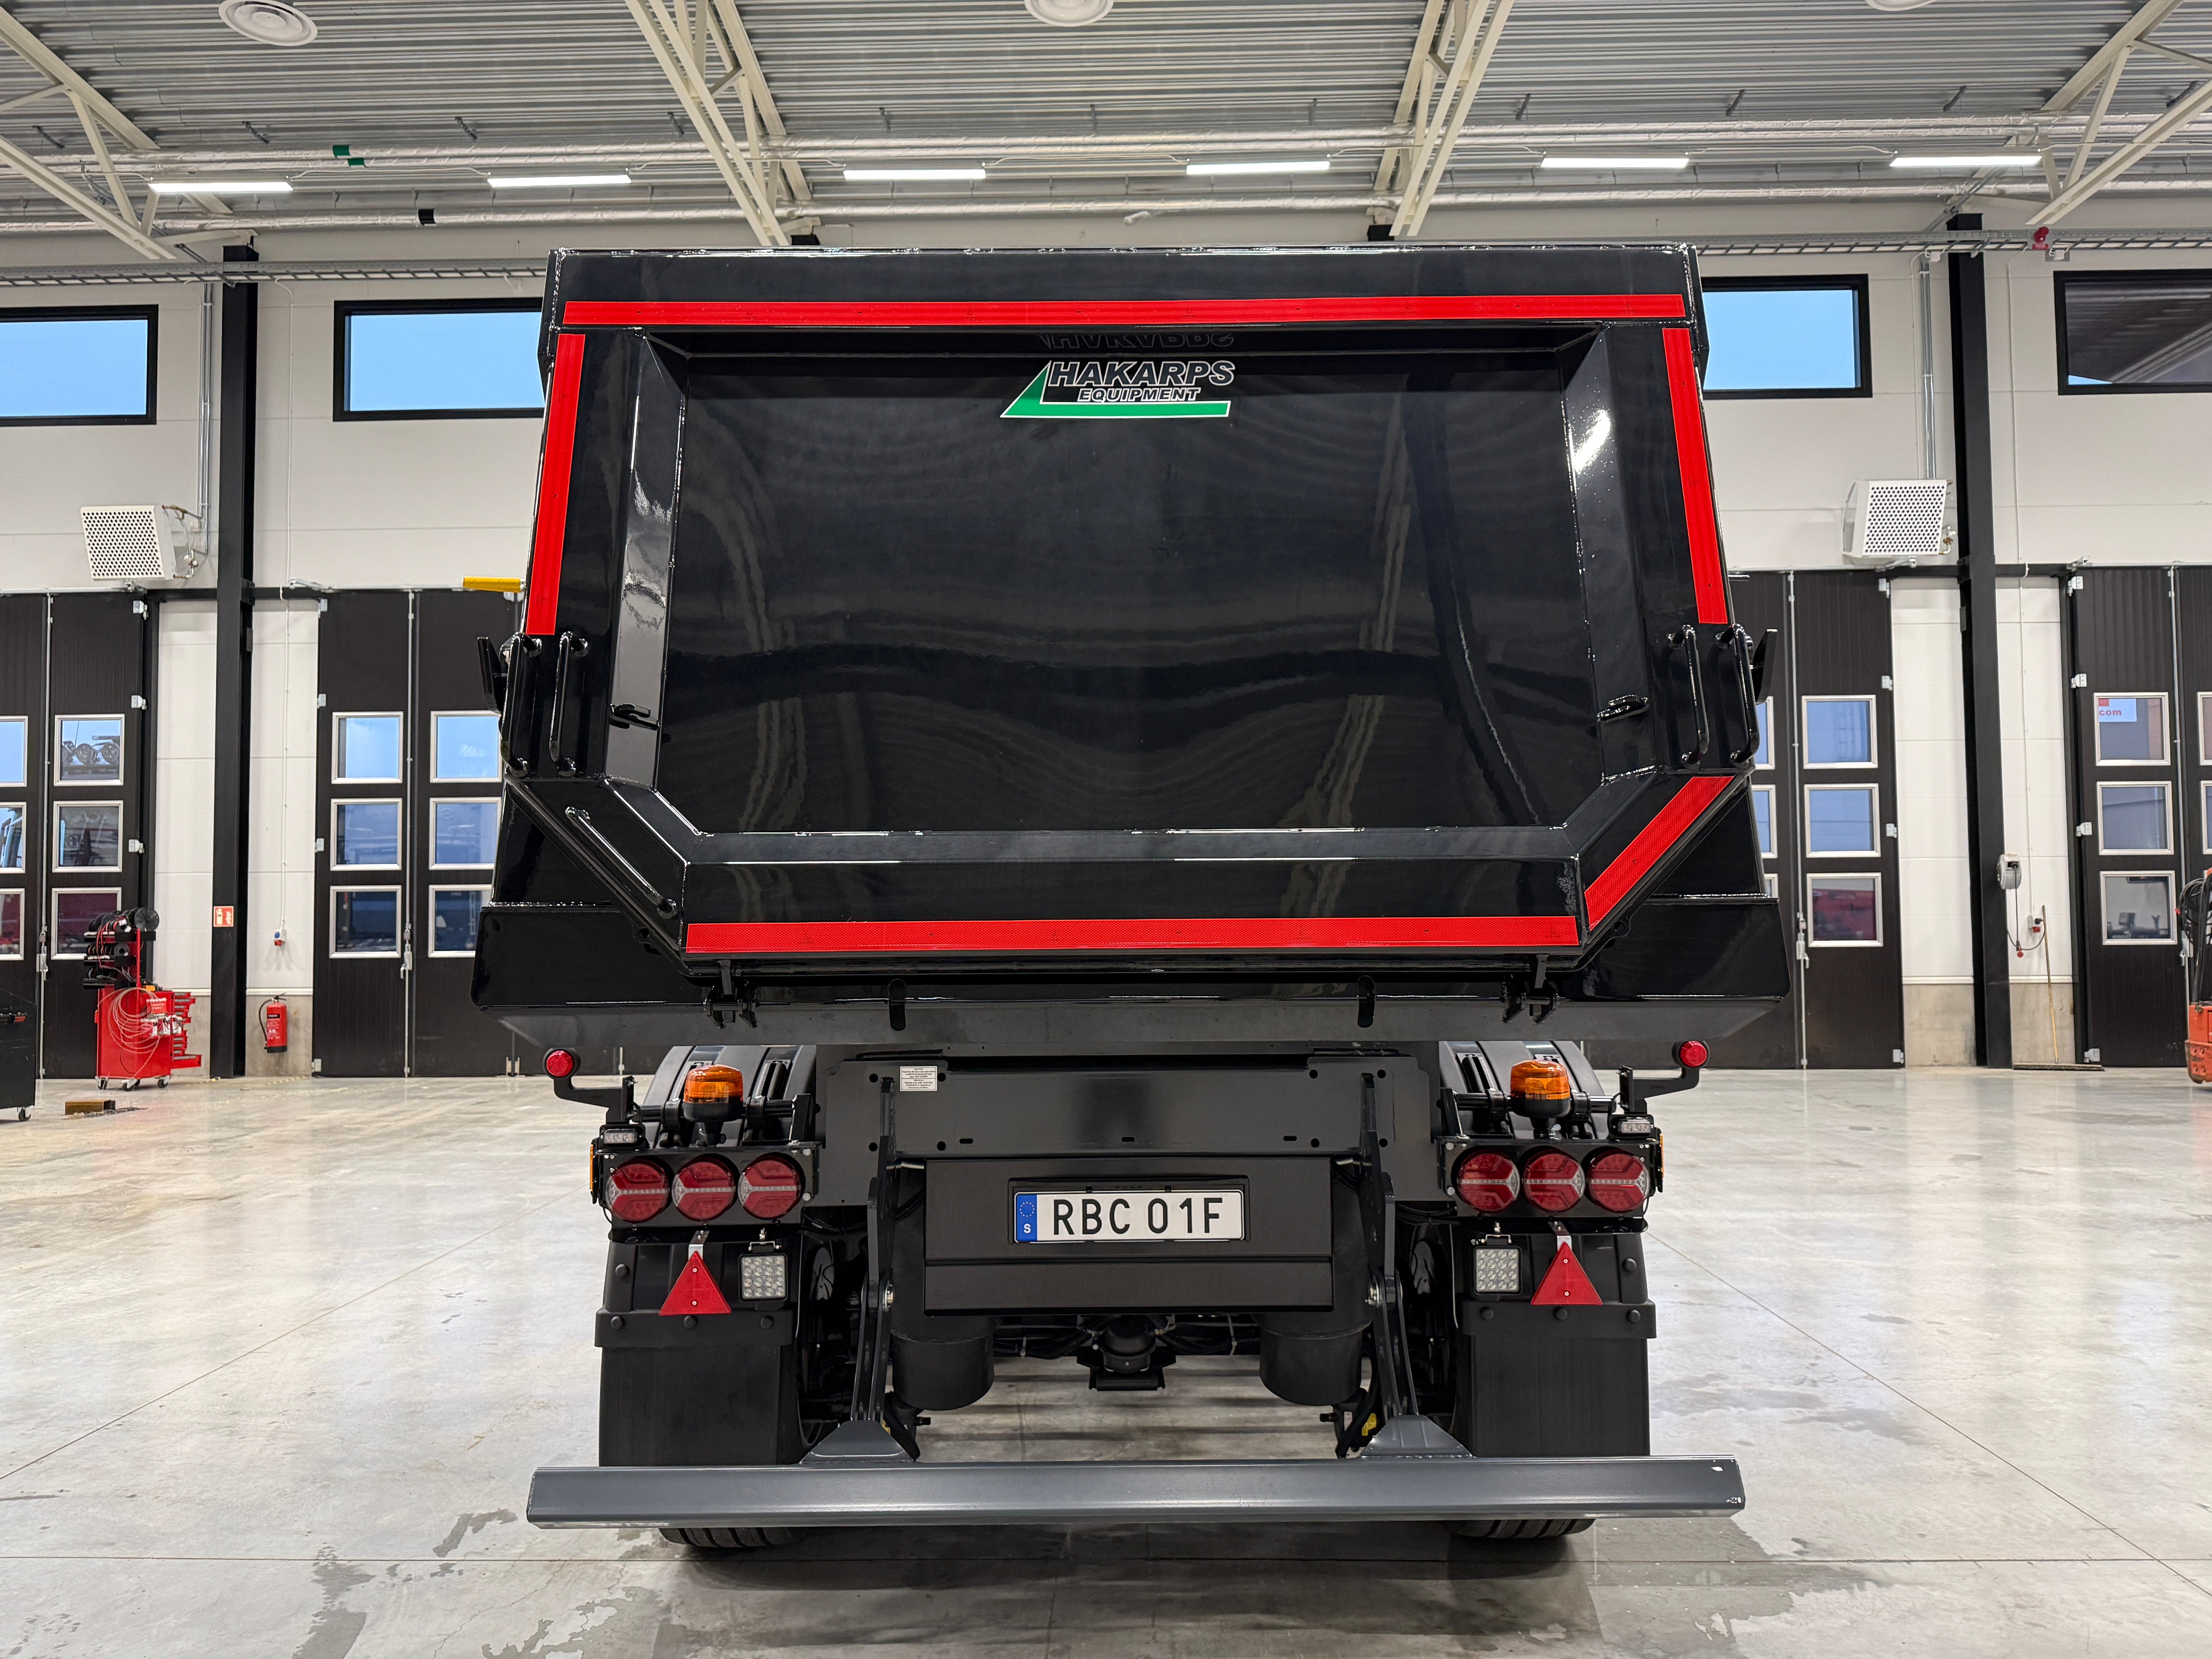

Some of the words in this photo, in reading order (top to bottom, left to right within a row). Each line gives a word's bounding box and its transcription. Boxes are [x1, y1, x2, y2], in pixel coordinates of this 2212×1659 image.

[1048, 360, 1235, 386] HAKARPS
[1077, 387, 1201, 402] EQUIPMENT
[1053, 1198, 1130, 1235] RBC
[1147, 1197, 1223, 1234] 01F
[1024, 1223, 1031, 1233] S
